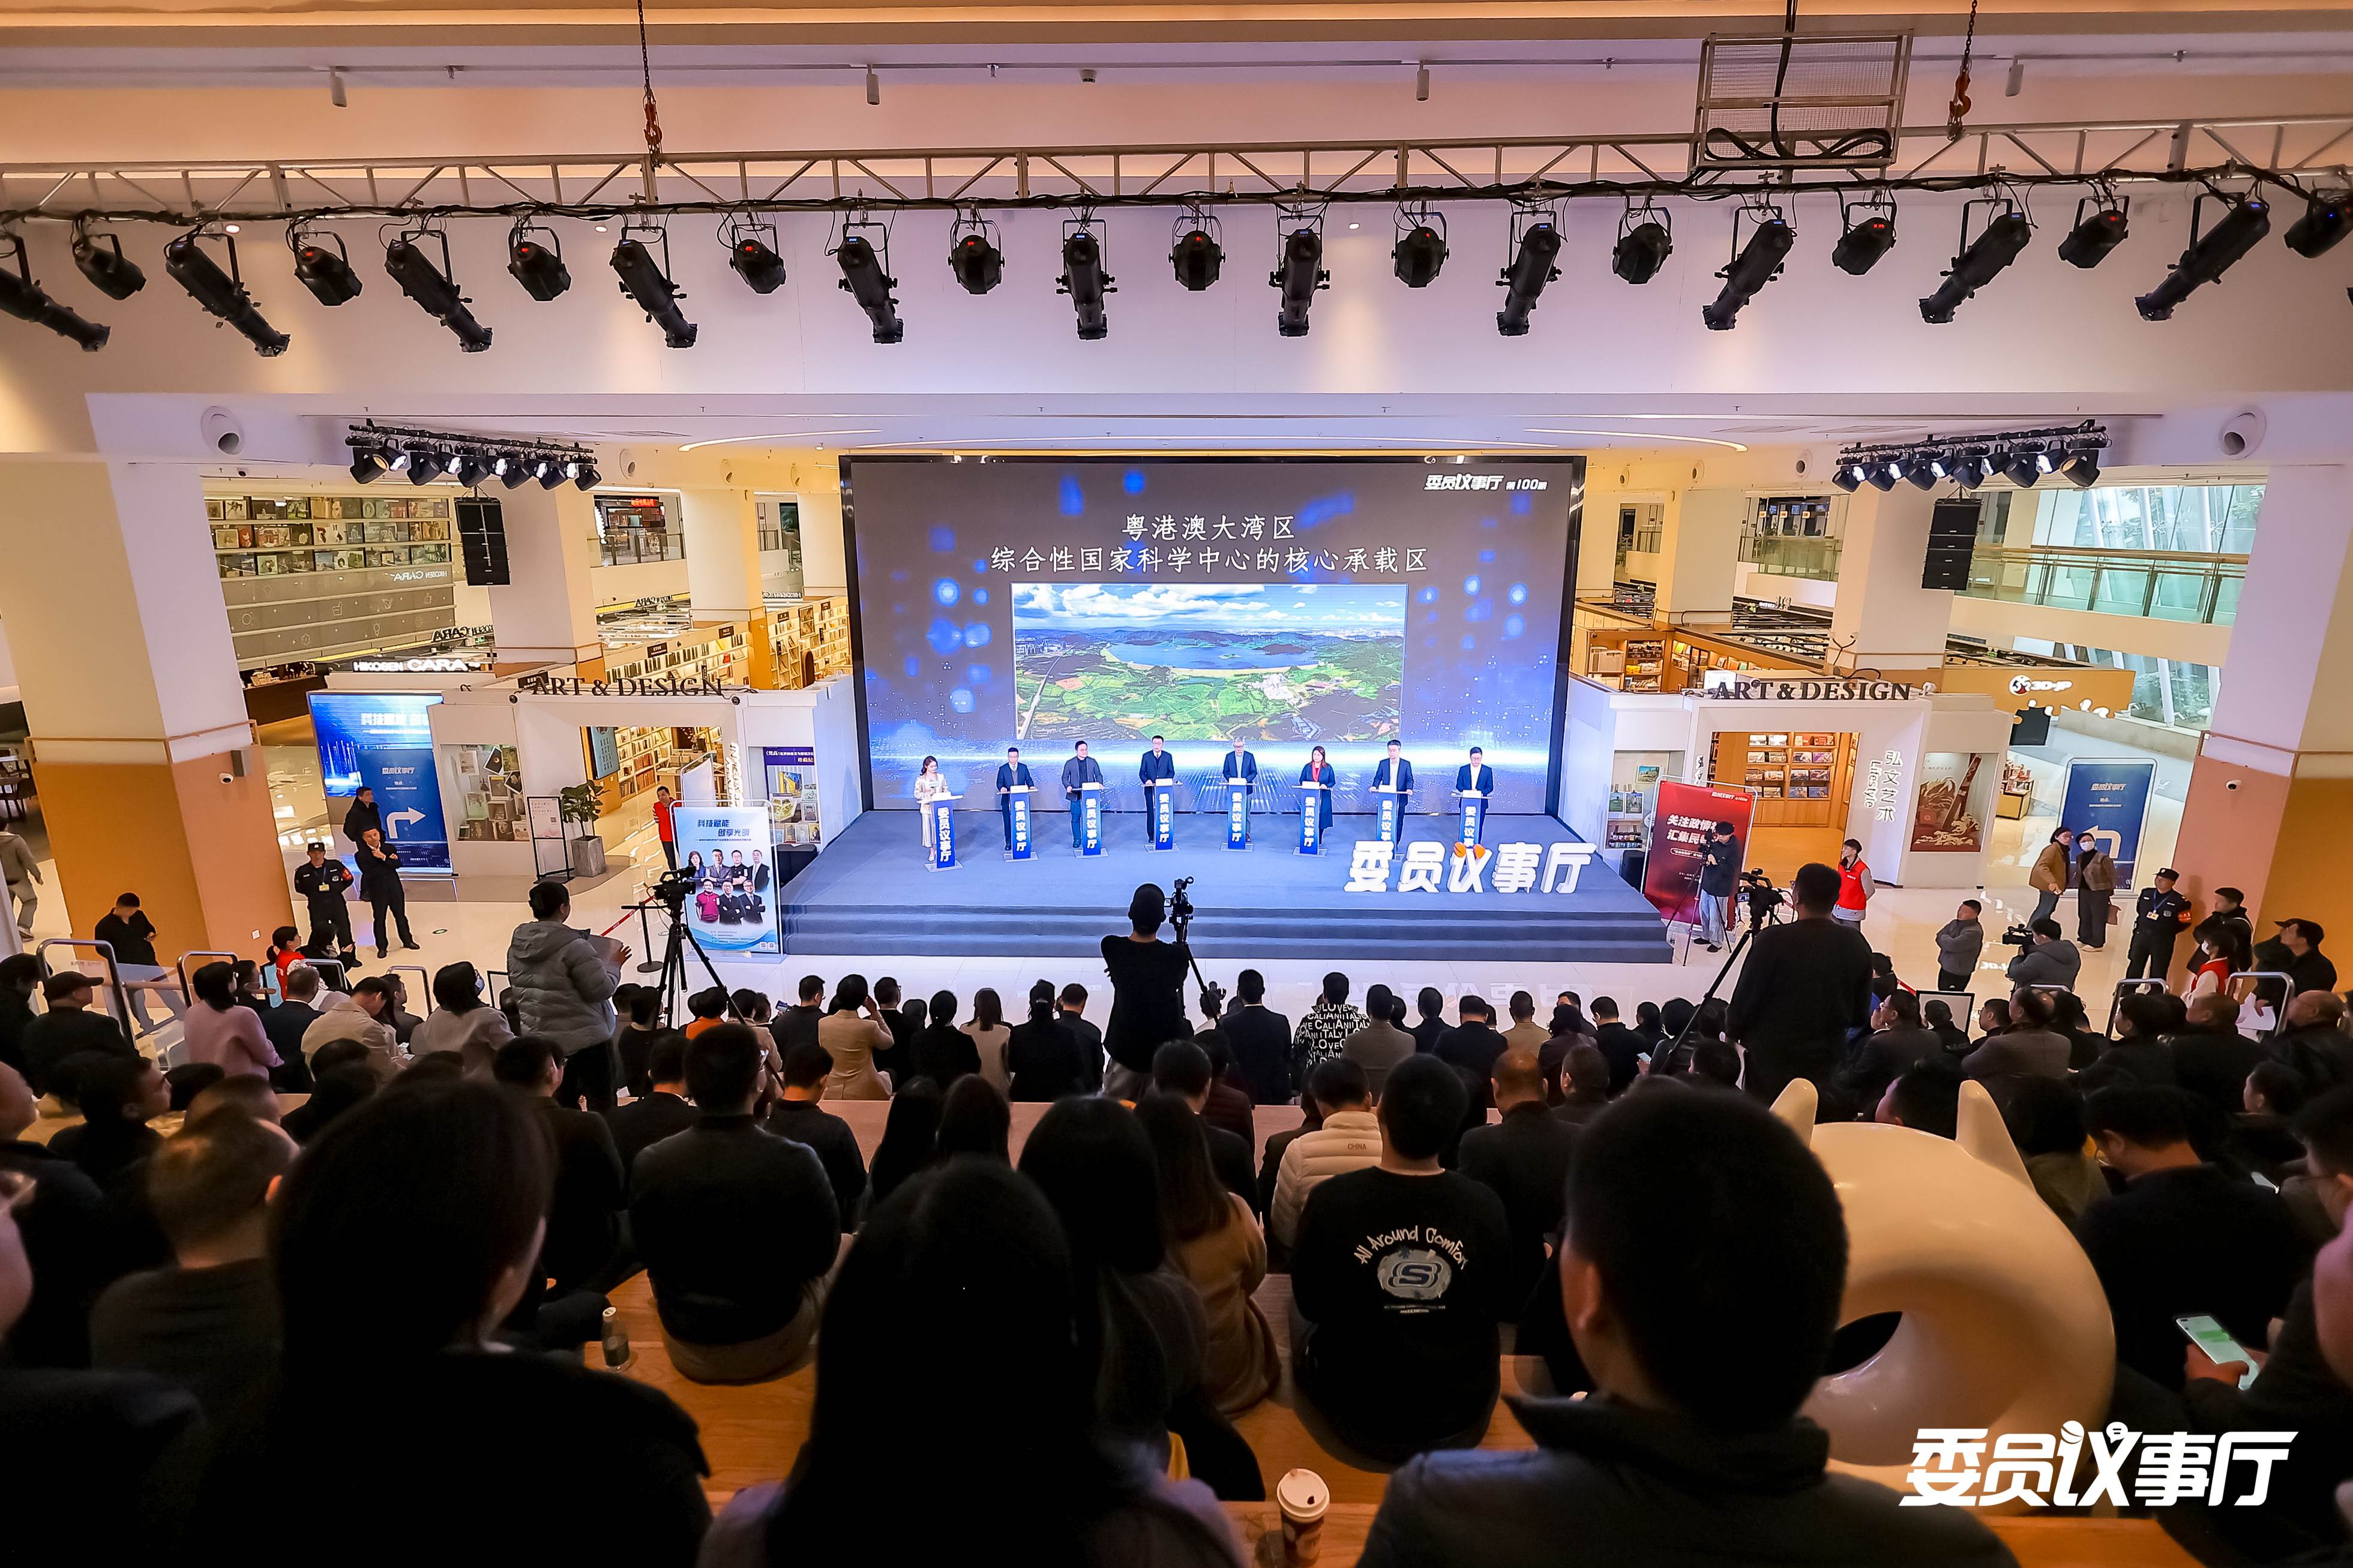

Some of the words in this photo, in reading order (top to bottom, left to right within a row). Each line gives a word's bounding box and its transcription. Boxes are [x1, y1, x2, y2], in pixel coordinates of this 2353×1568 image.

[1424, 473, 1504, 491] 委员议事厅
[1122, 513, 1296, 542] 粤港澳大湾区
[990, 545, 1428, 574] 综合性国家科学中心的核心承载区
[407, 659, 468, 671] CARA
[532, 676, 585, 696] ART
[592, 679, 611, 696] &
[617, 676, 724, 696] DESIGN
[1714, 681, 1774, 700] ART
[1777, 683, 1797, 700] &
[1801, 682, 1913, 700] DESIGN
[1863, 760, 1883, 808] Lifestyle
[1875, 750, 1904, 823] 弘文艺术
[697, 819, 730, 828] 科技赋能
[718, 828, 750, 837] 创享光明
[937, 807, 952, 862] 委员议事厅
[1014, 800, 1027, 852] 委员议事厅
[1086, 798, 1098, 849] 委员议事厅
[1159, 793, 1170, 843] 委员议事厅
[1231, 792, 1242, 842] 委员议事厅
[1303, 796, 1316, 847] 委员议事厅
[1381, 800, 1393, 841] 委员议事
[1463, 806, 1477, 847] 委员议事
[1344, 841, 1597, 894] 委员议事厅
[1366, 1225, 1419, 1251] Around
